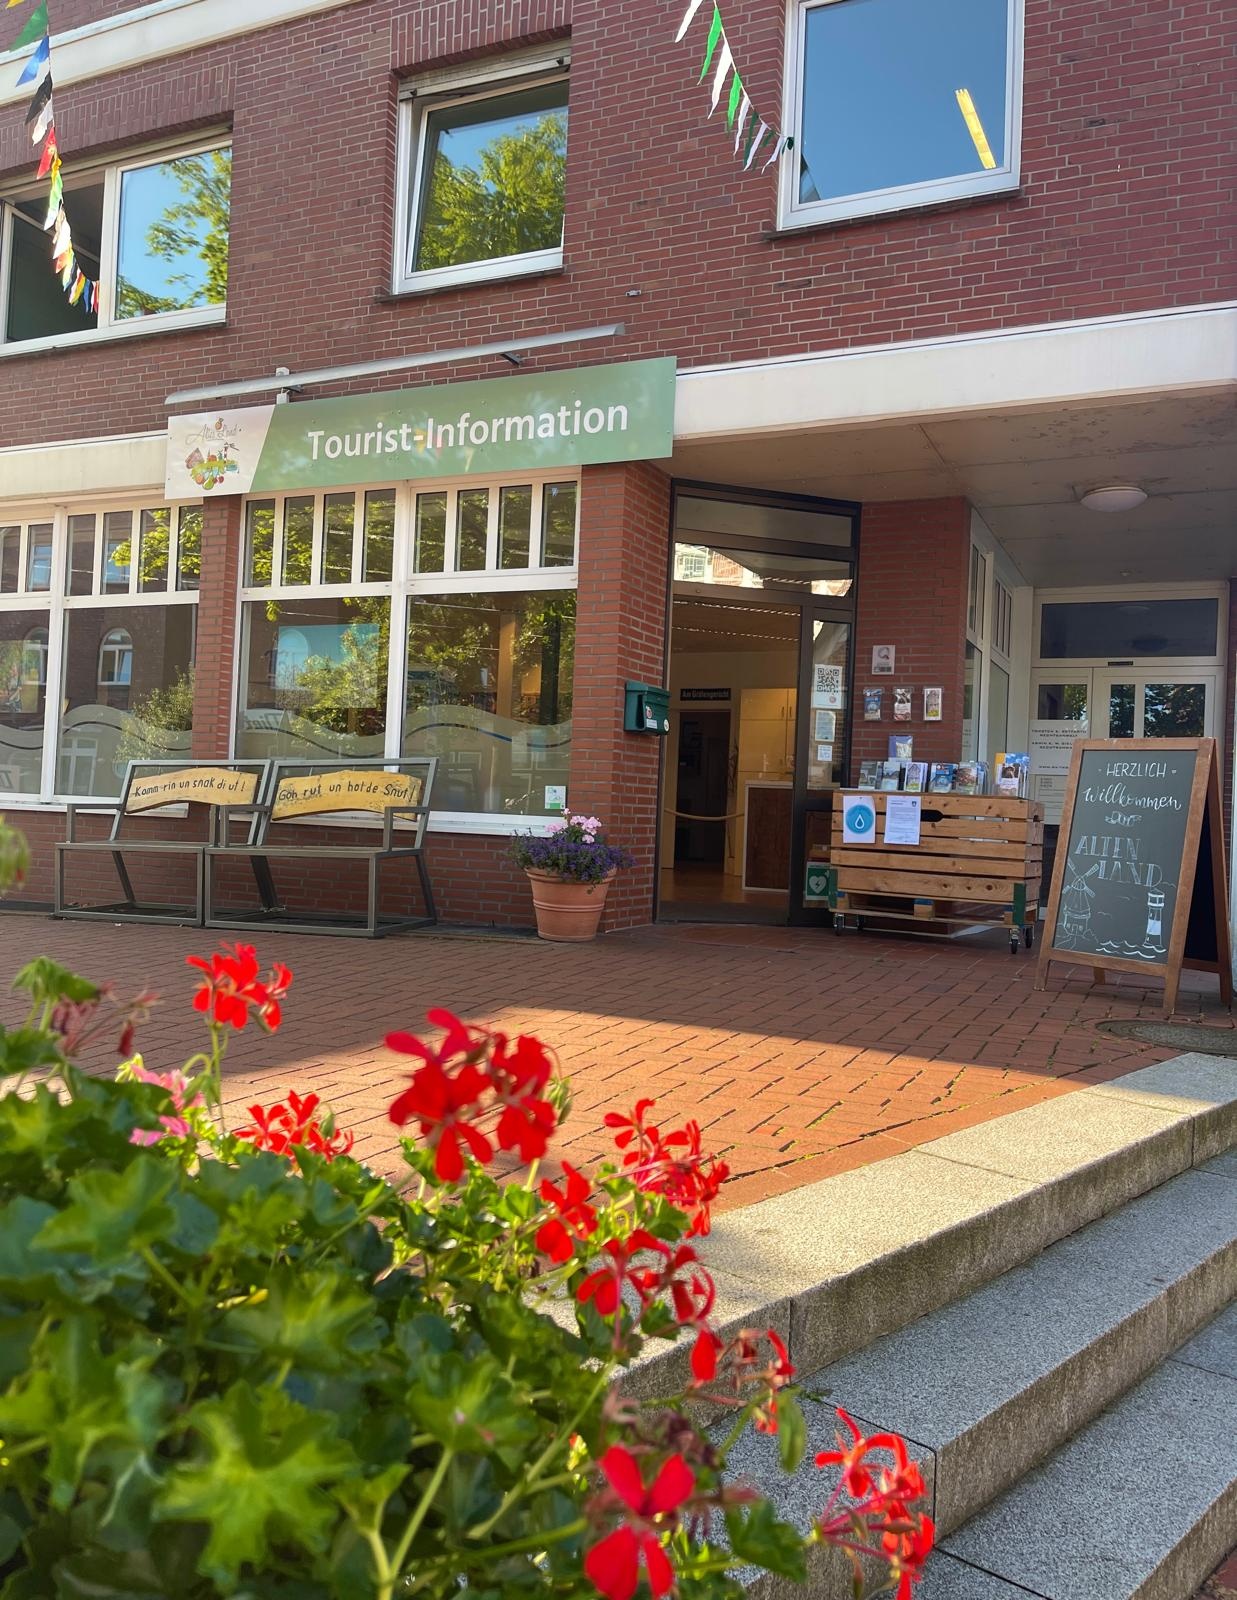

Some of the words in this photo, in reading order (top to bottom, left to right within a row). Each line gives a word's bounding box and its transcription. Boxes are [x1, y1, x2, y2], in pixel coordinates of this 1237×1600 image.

[307, 400, 628, 460] Tourist-Information
[1105, 762, 1168, 778] HERZLICH
[179, 780, 190, 789] un
[216, 779, 226, 790] di
[278, 789, 298, 801] Goh
[303, 784, 321, 797] rut
[329, 783, 342, 792] un
[1074, 835, 1141, 860] ALTEN
[1097, 860, 1163, 888] LAND
